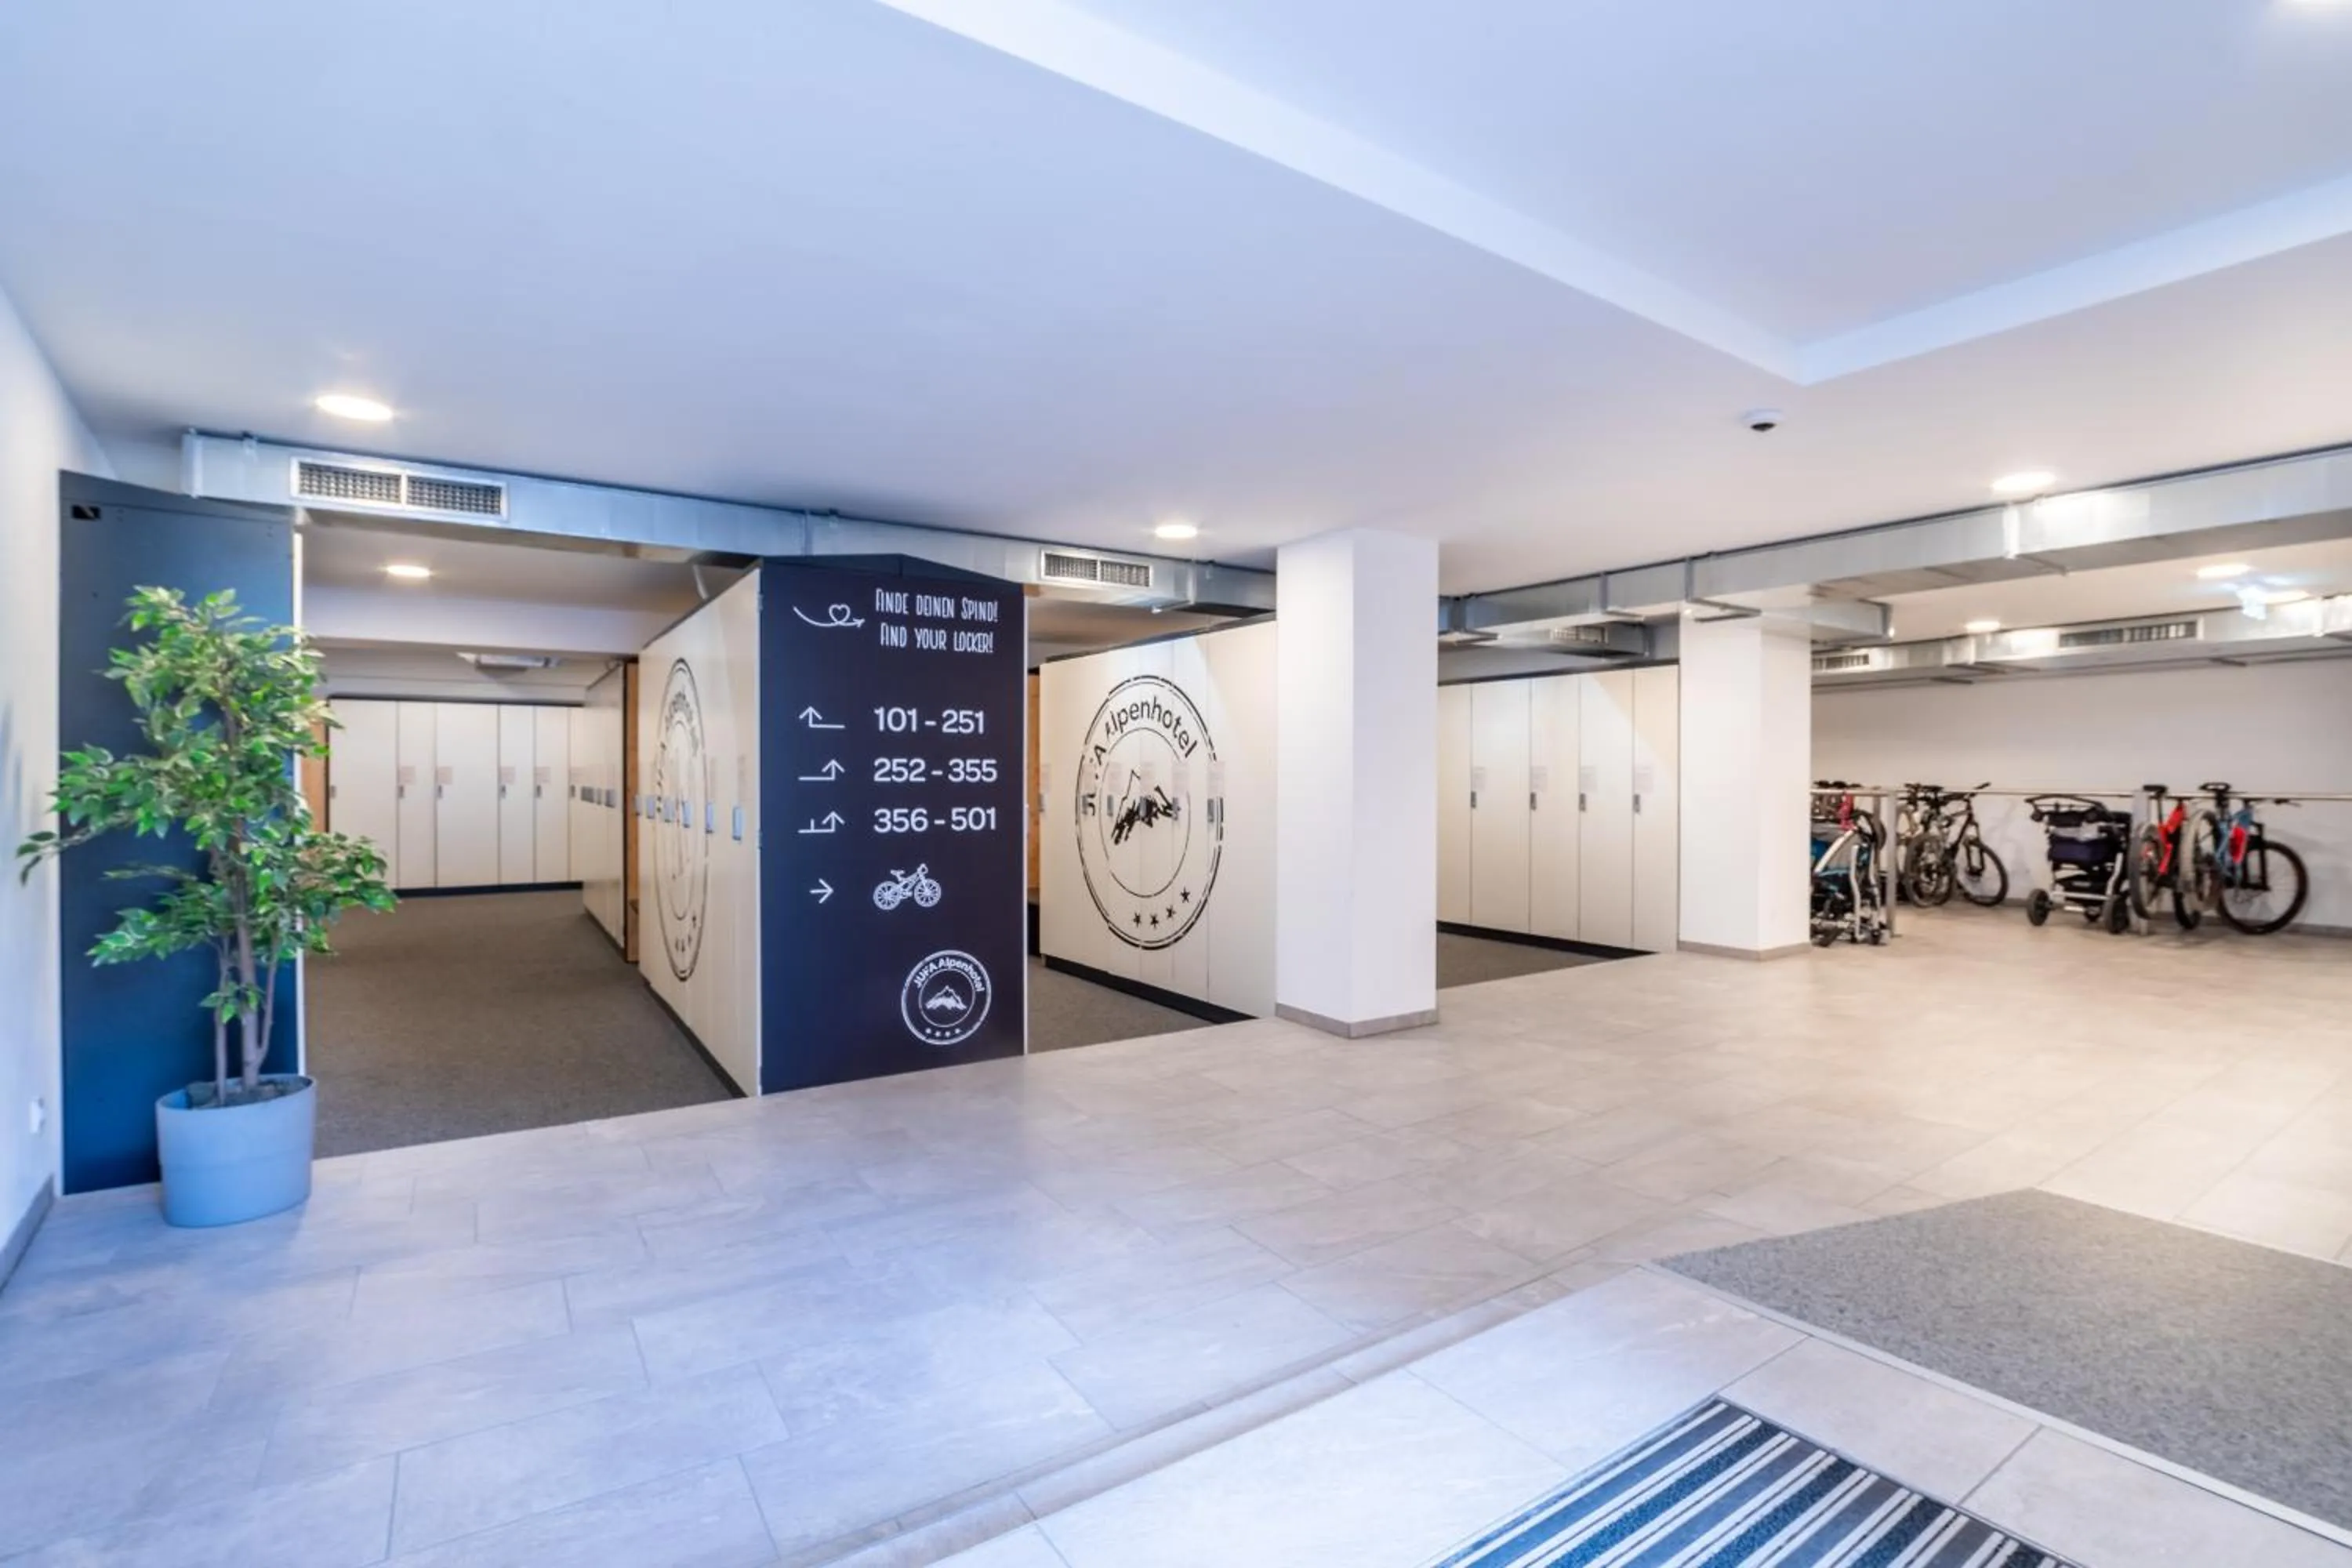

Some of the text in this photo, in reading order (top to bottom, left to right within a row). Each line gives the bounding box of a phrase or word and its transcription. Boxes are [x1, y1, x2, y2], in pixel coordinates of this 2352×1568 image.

[913, 627, 947, 651] YOUR
[953, 630, 994, 654] LOCKER!
[913, 956, 985, 992] JUFA Alpenhotel
